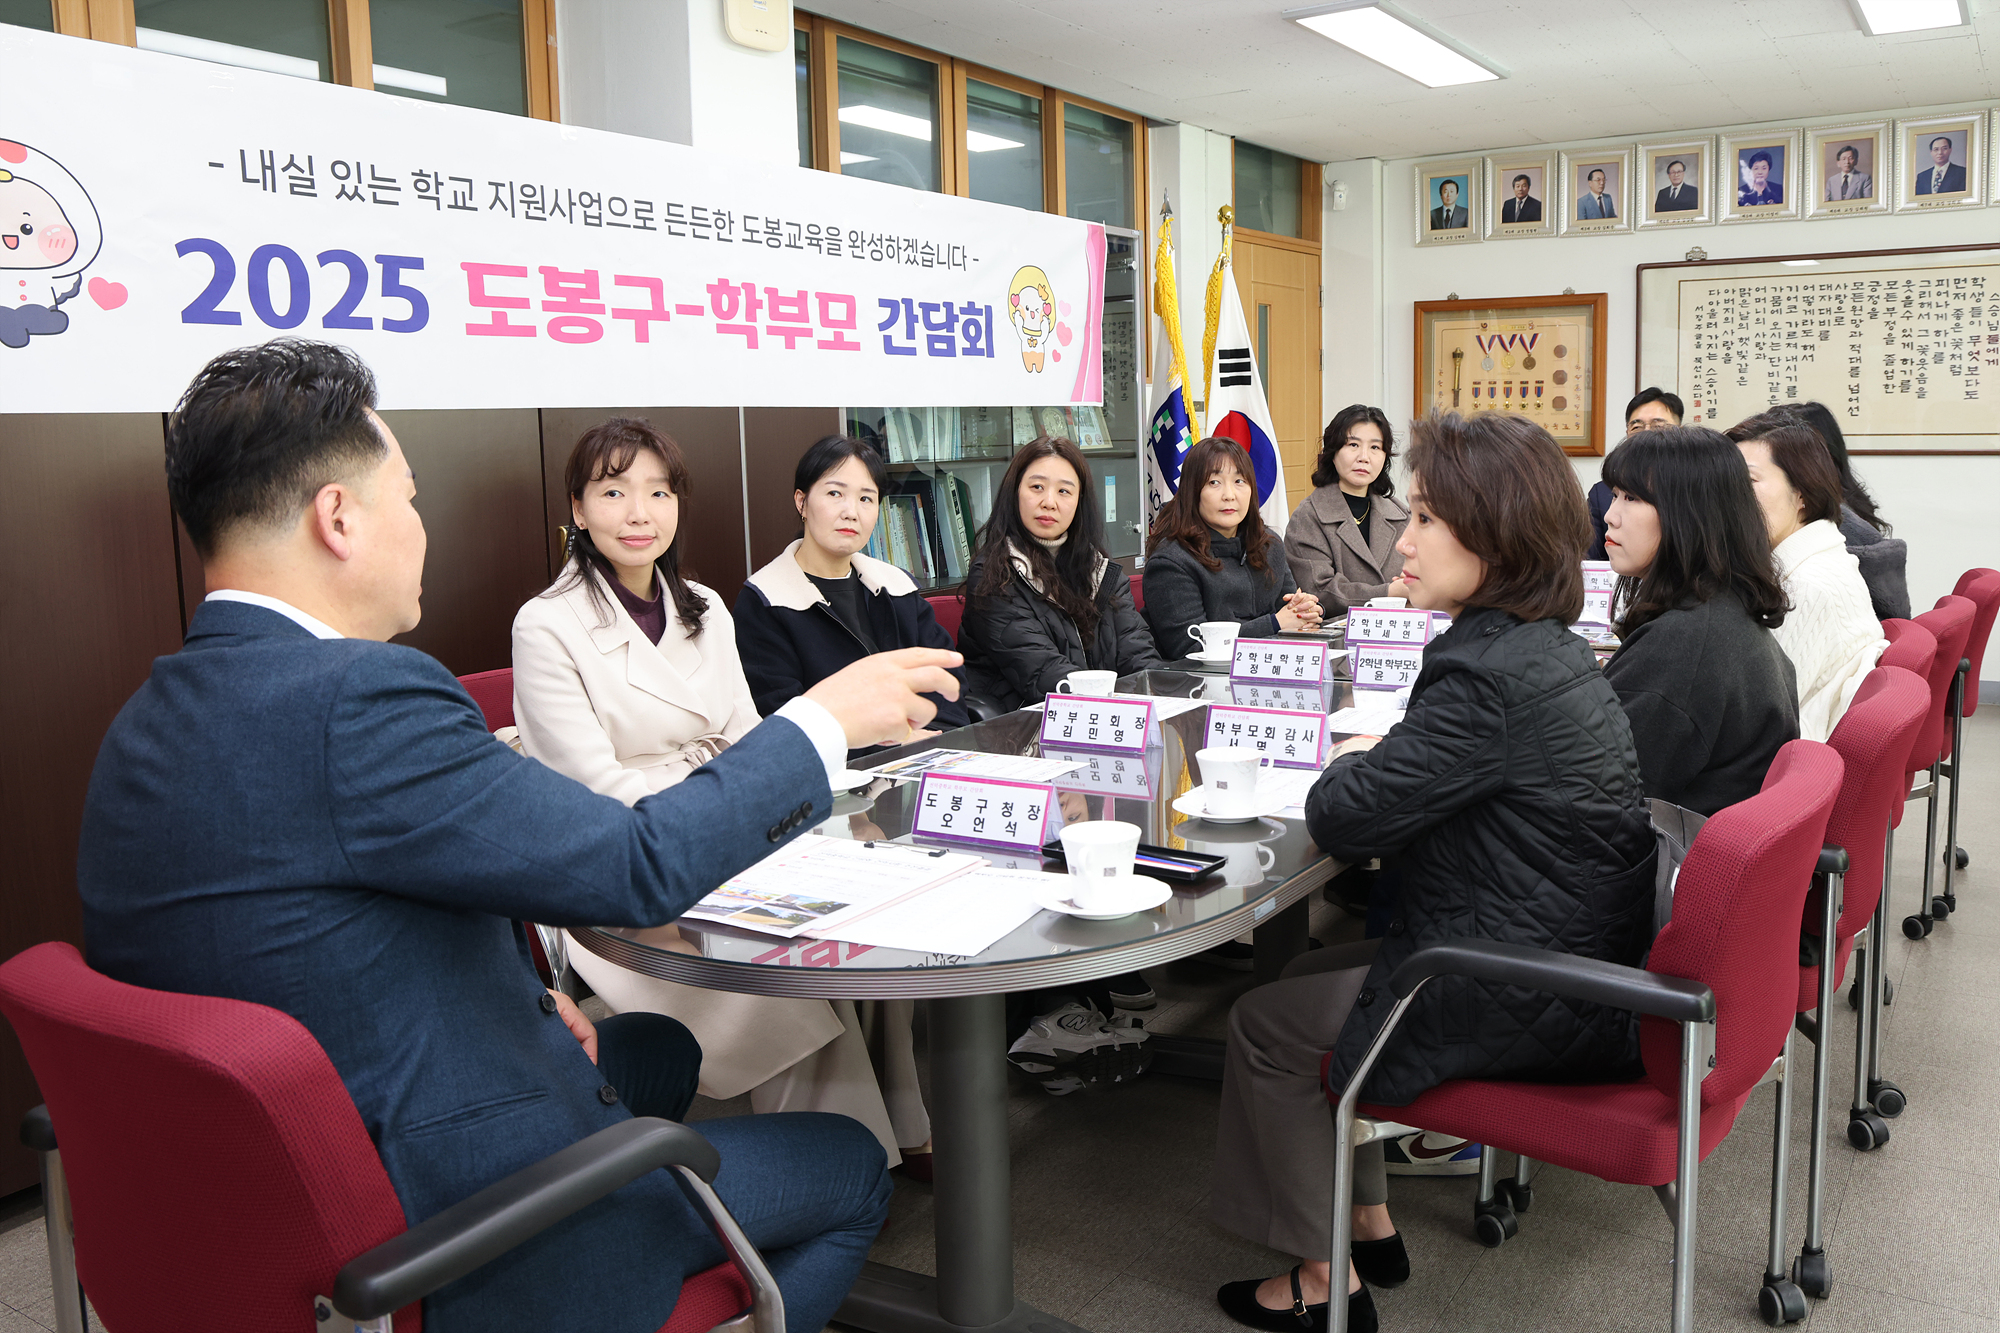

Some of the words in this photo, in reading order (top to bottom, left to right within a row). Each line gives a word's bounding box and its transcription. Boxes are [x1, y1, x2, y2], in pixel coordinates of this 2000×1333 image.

[240, 149, 317, 197] 내실
[331, 160, 401, 205] 있는
[411, 169, 478, 211] 학교
[488, 181, 656, 231] 지원사업으로
[665, 203, 734, 242] 든든한
[742, 215, 842, 256] 도봉교육을
[848, 231, 967, 271] 완성하겠습니다
[175, 238, 429, 333] 2025
[460, 260, 864, 352] 도봉구-학부모
[878, 298, 994, 358] 간담회
[1867, 281, 1882, 319] 긍정을
[1953, 278, 1967, 300] 먼저
[1833, 283, 1848, 326] 사랑으로
[1363, 629, 1410, 639] 박세연
[1250, 664, 1303, 676] 정혜선
[1358, 657, 1382, 669] 2학년
[1063, 726, 1123, 742] 김민영
[940, 812, 1017, 838] 오언석
